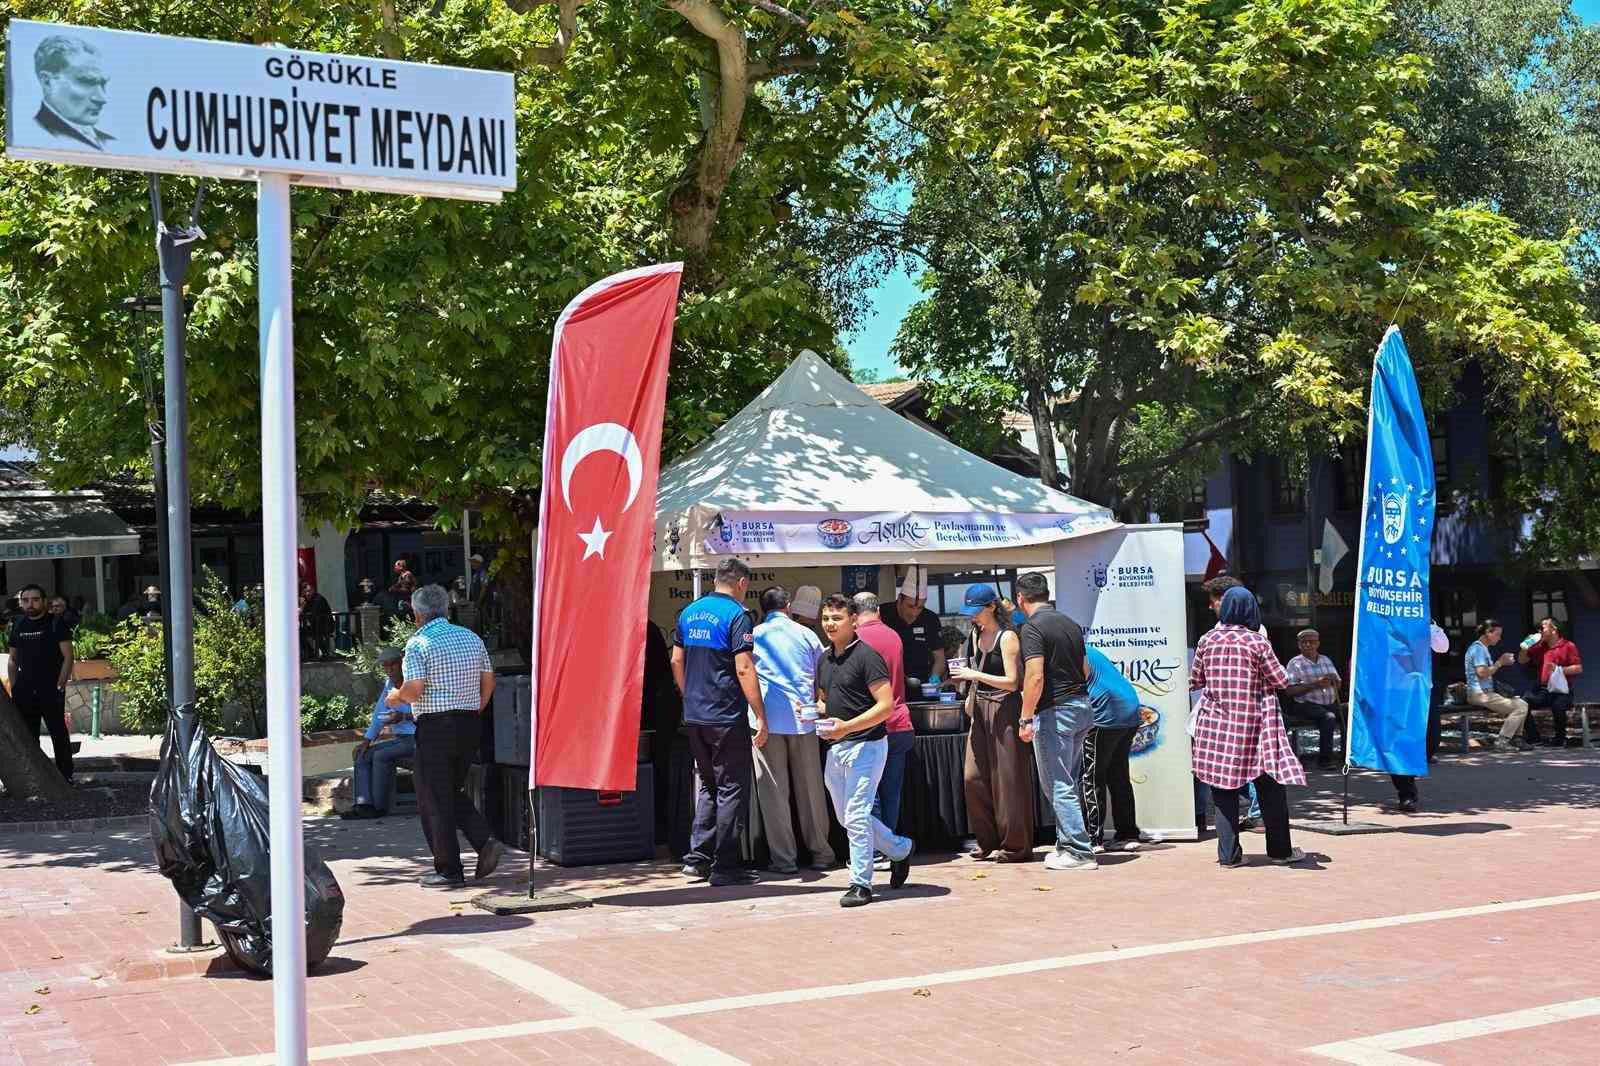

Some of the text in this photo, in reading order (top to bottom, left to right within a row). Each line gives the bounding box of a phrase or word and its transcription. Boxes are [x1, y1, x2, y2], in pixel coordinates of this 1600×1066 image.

[266, 56, 397, 89] GÖRÜKLE
[147, 86, 506, 177] CUMHURİYET MEYDANI
[742, 521, 775, 530] BURSA
[936, 533, 982, 542] Bereketin
[1118, 566, 1153, 575] BURSA
[1367, 566, 1422, 588] BURSA
[1368, 585, 1423, 603] BÜYÜKŞEHİR
[1366, 601, 1424, 618] BELEDİYESİ
[1127, 637, 1168, 648] Simgesi
